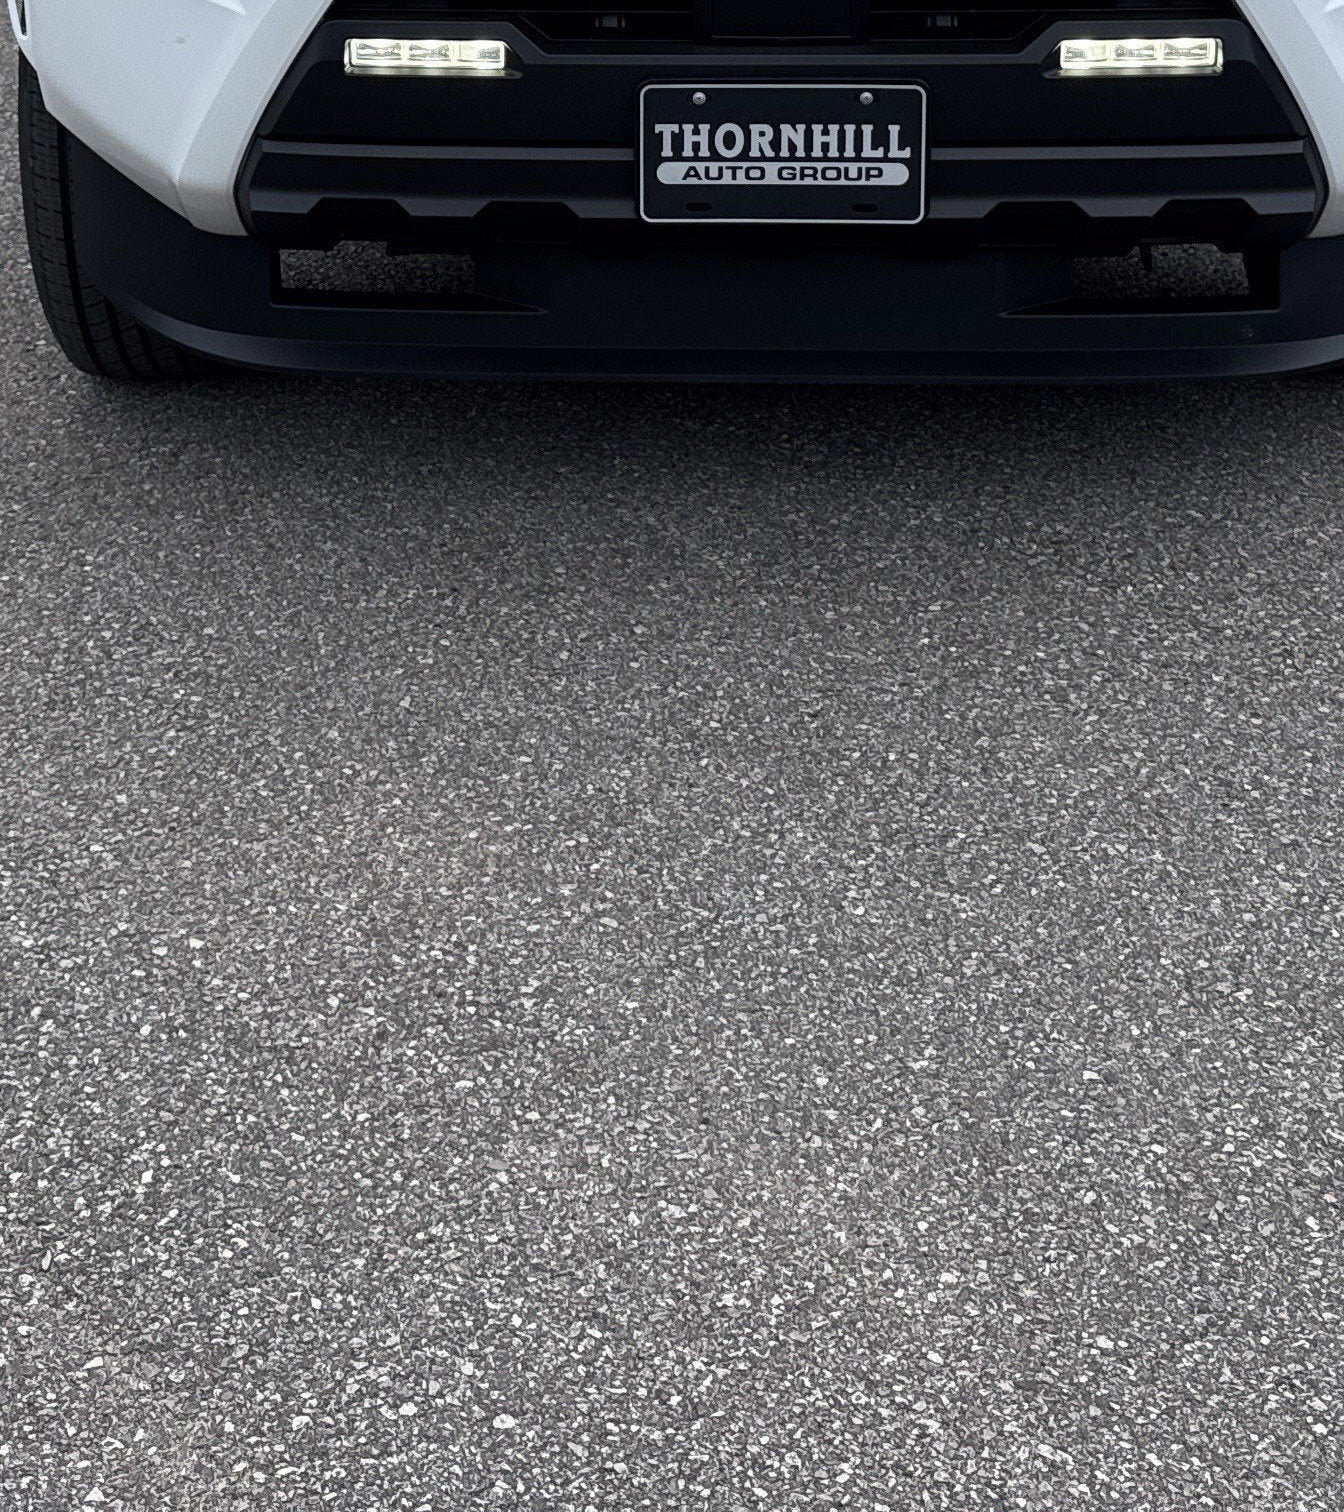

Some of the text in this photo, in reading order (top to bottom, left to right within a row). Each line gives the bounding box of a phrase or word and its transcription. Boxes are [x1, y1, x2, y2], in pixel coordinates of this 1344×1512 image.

[654, 122, 911, 158] THORNHILL
[682, 165, 884, 182] AUTO GROUP
